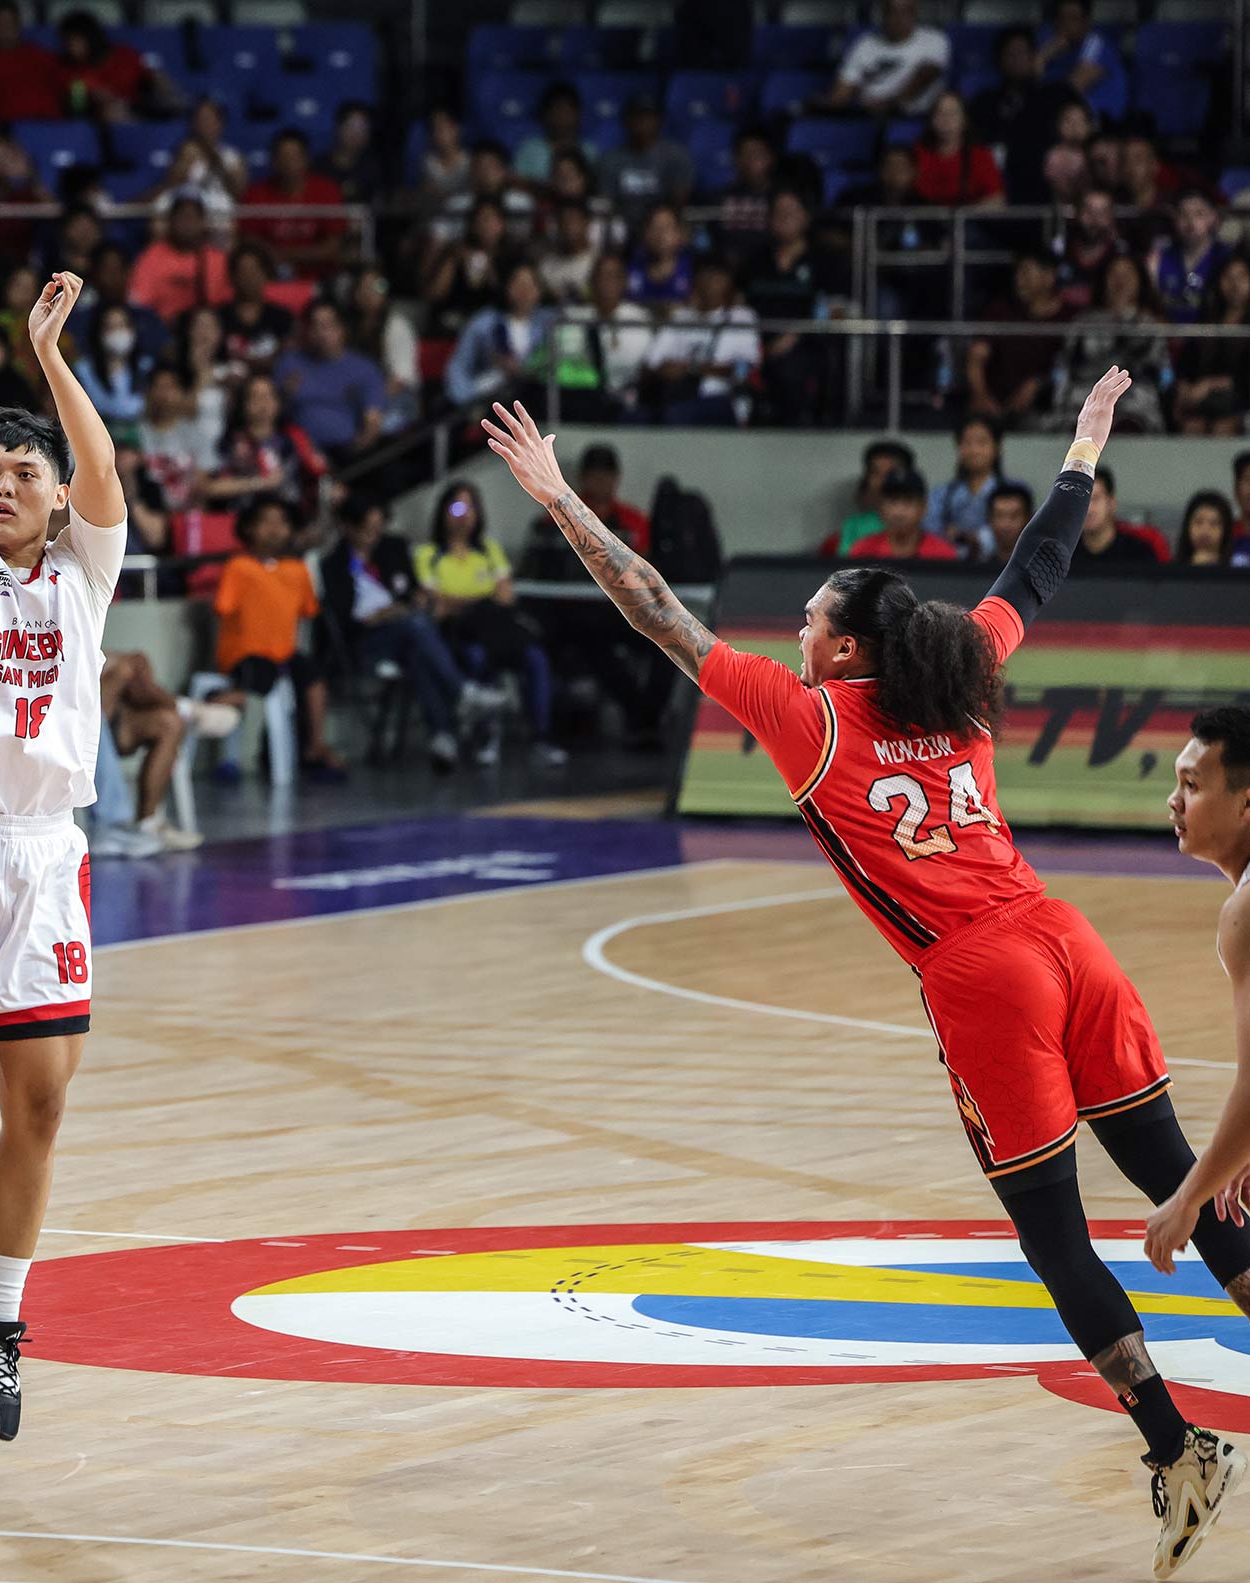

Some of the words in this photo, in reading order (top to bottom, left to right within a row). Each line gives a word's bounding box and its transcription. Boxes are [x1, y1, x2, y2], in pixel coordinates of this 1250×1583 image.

[28, 664, 59, 688] MIG
[872, 735, 956, 766] MONZON
[866, 760, 1002, 862] 24
[52, 941, 89, 984] 18
